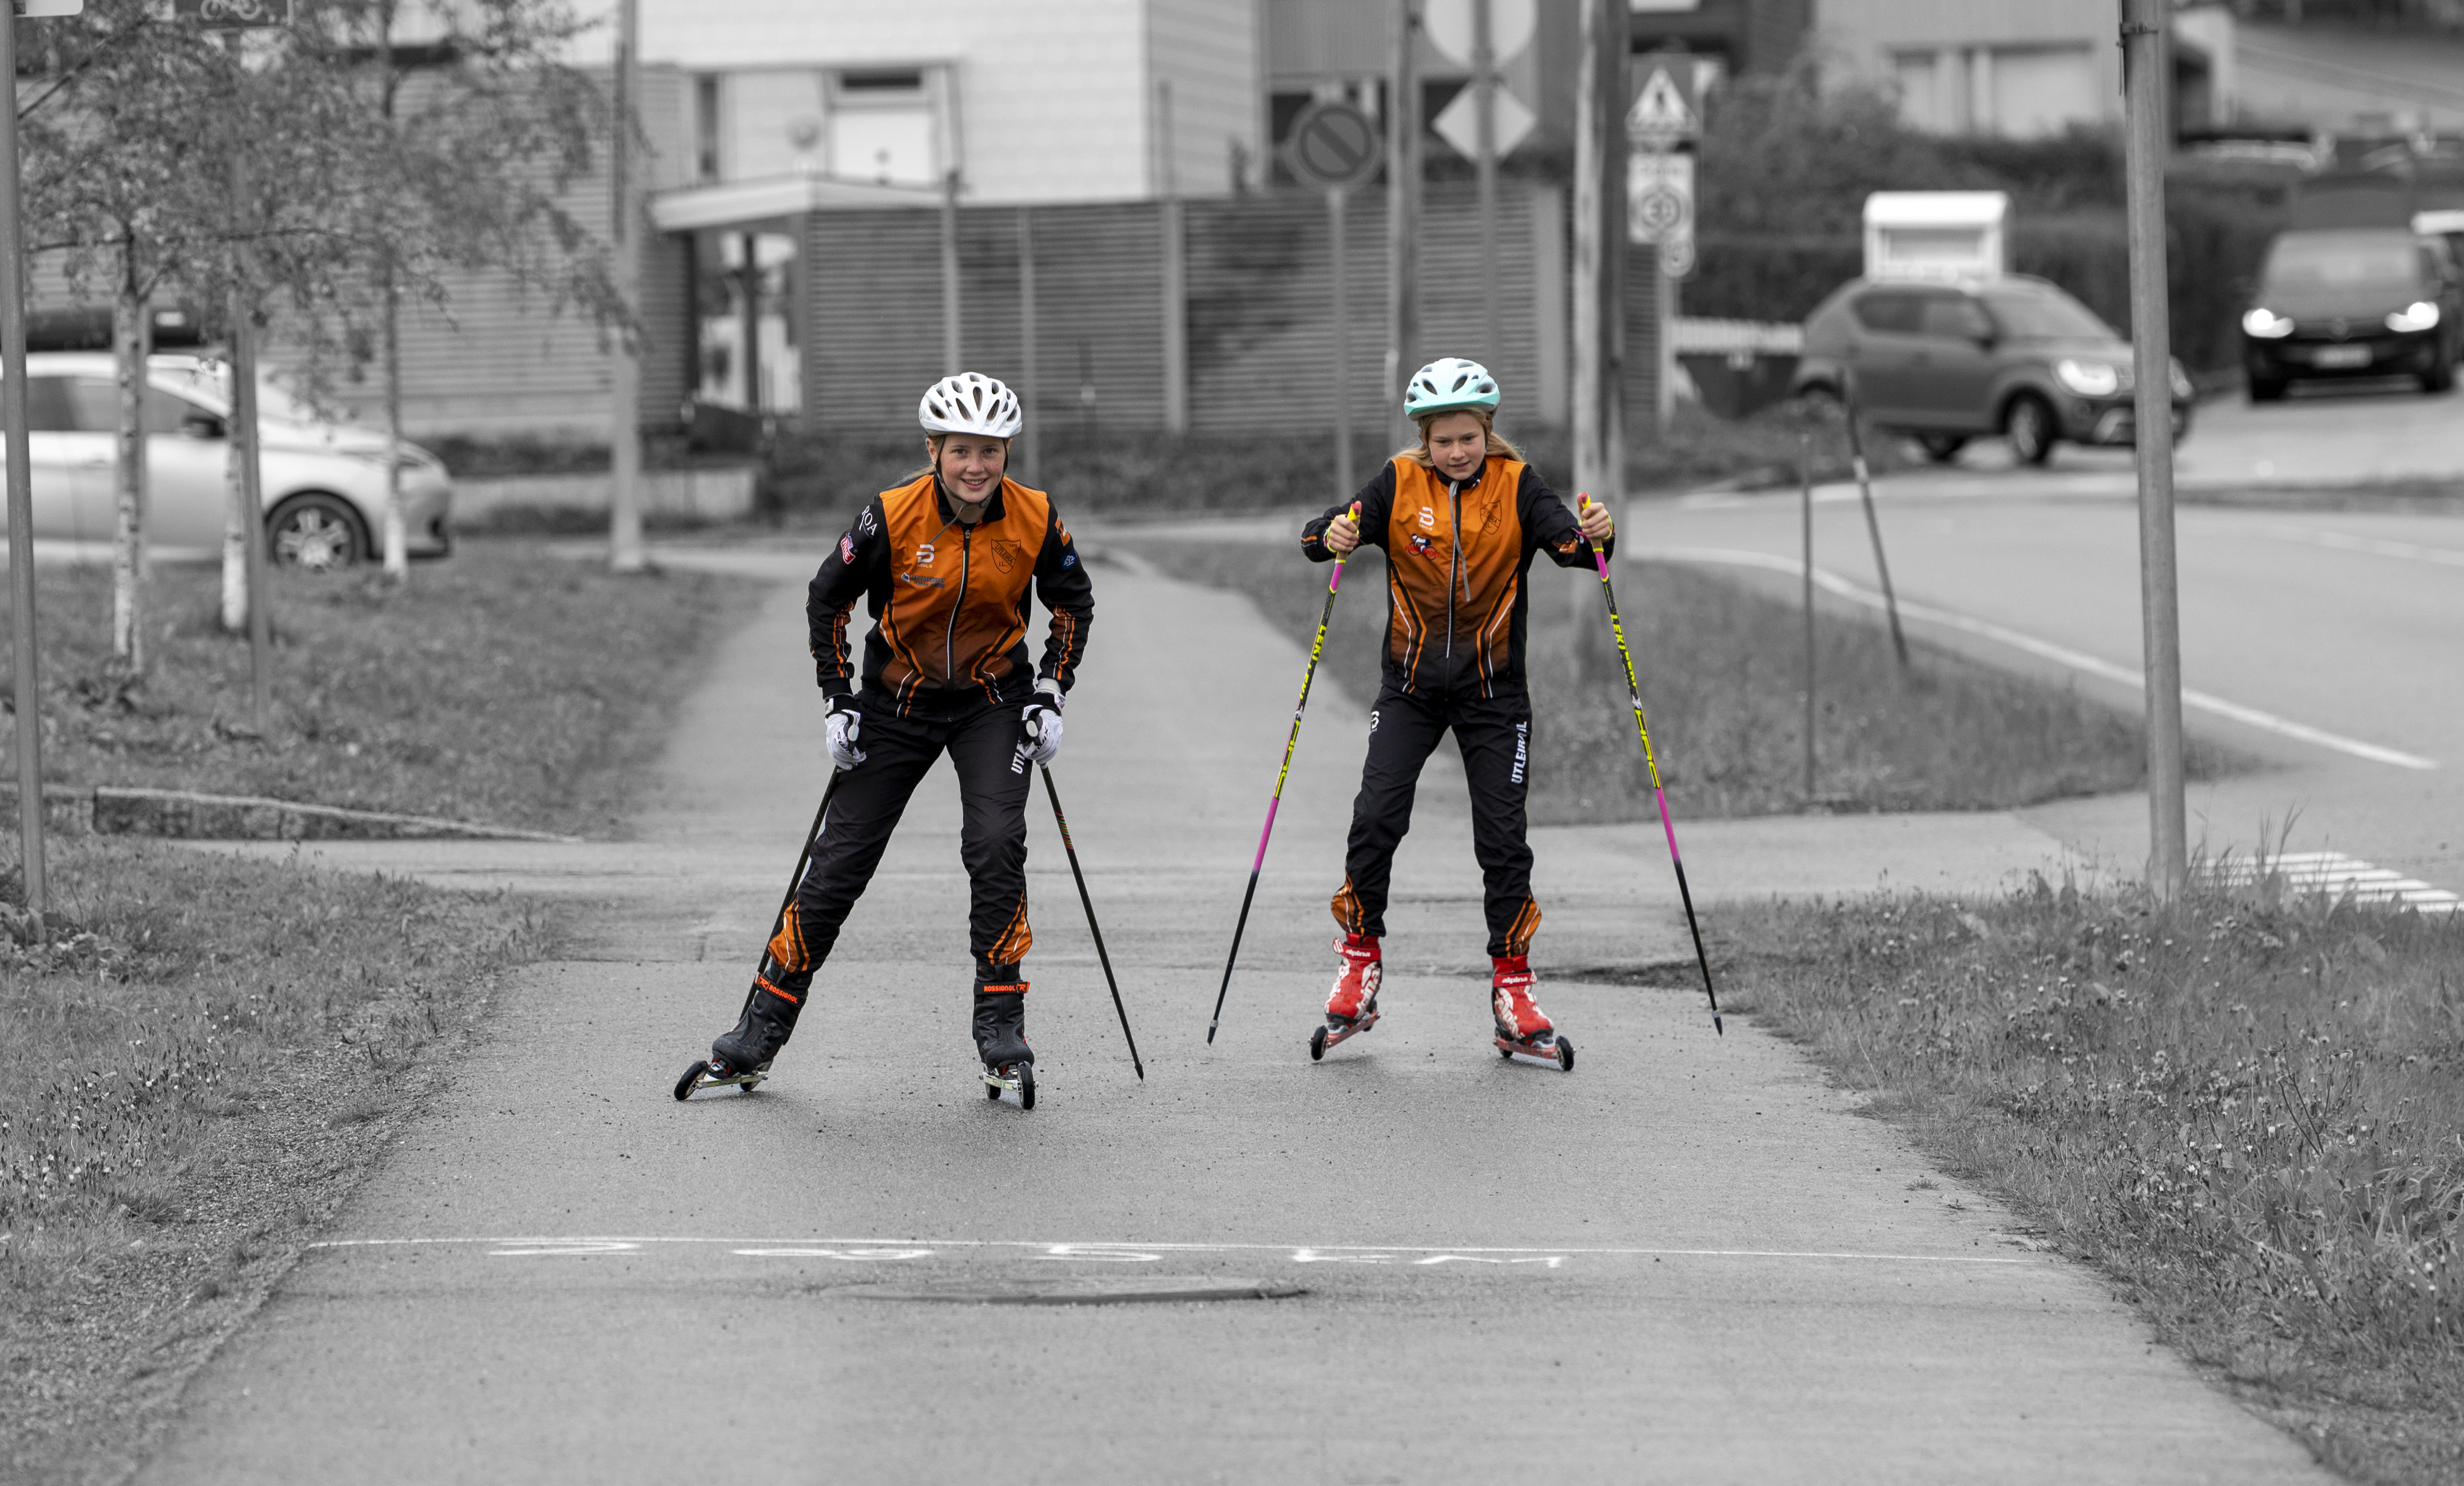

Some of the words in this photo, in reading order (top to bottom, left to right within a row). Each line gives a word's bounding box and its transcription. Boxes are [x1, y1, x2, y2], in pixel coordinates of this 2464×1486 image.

[995, 544, 1014, 564] UTLEIRA
[1610, 614, 1626, 650] LEKI
[1312, 624, 1327, 662] LEKI
[1516, 721, 1527, 733] IL
[1511, 732, 1527, 784] UTLEIRA
[1346, 948, 1371, 957] alpina
[1502, 976, 1528, 984] alpina
[769, 984, 797, 1004] ROSSIGNOL
[486, 1241, 646, 1255] 2
[1027, 1245, 1231, 1262] 5
